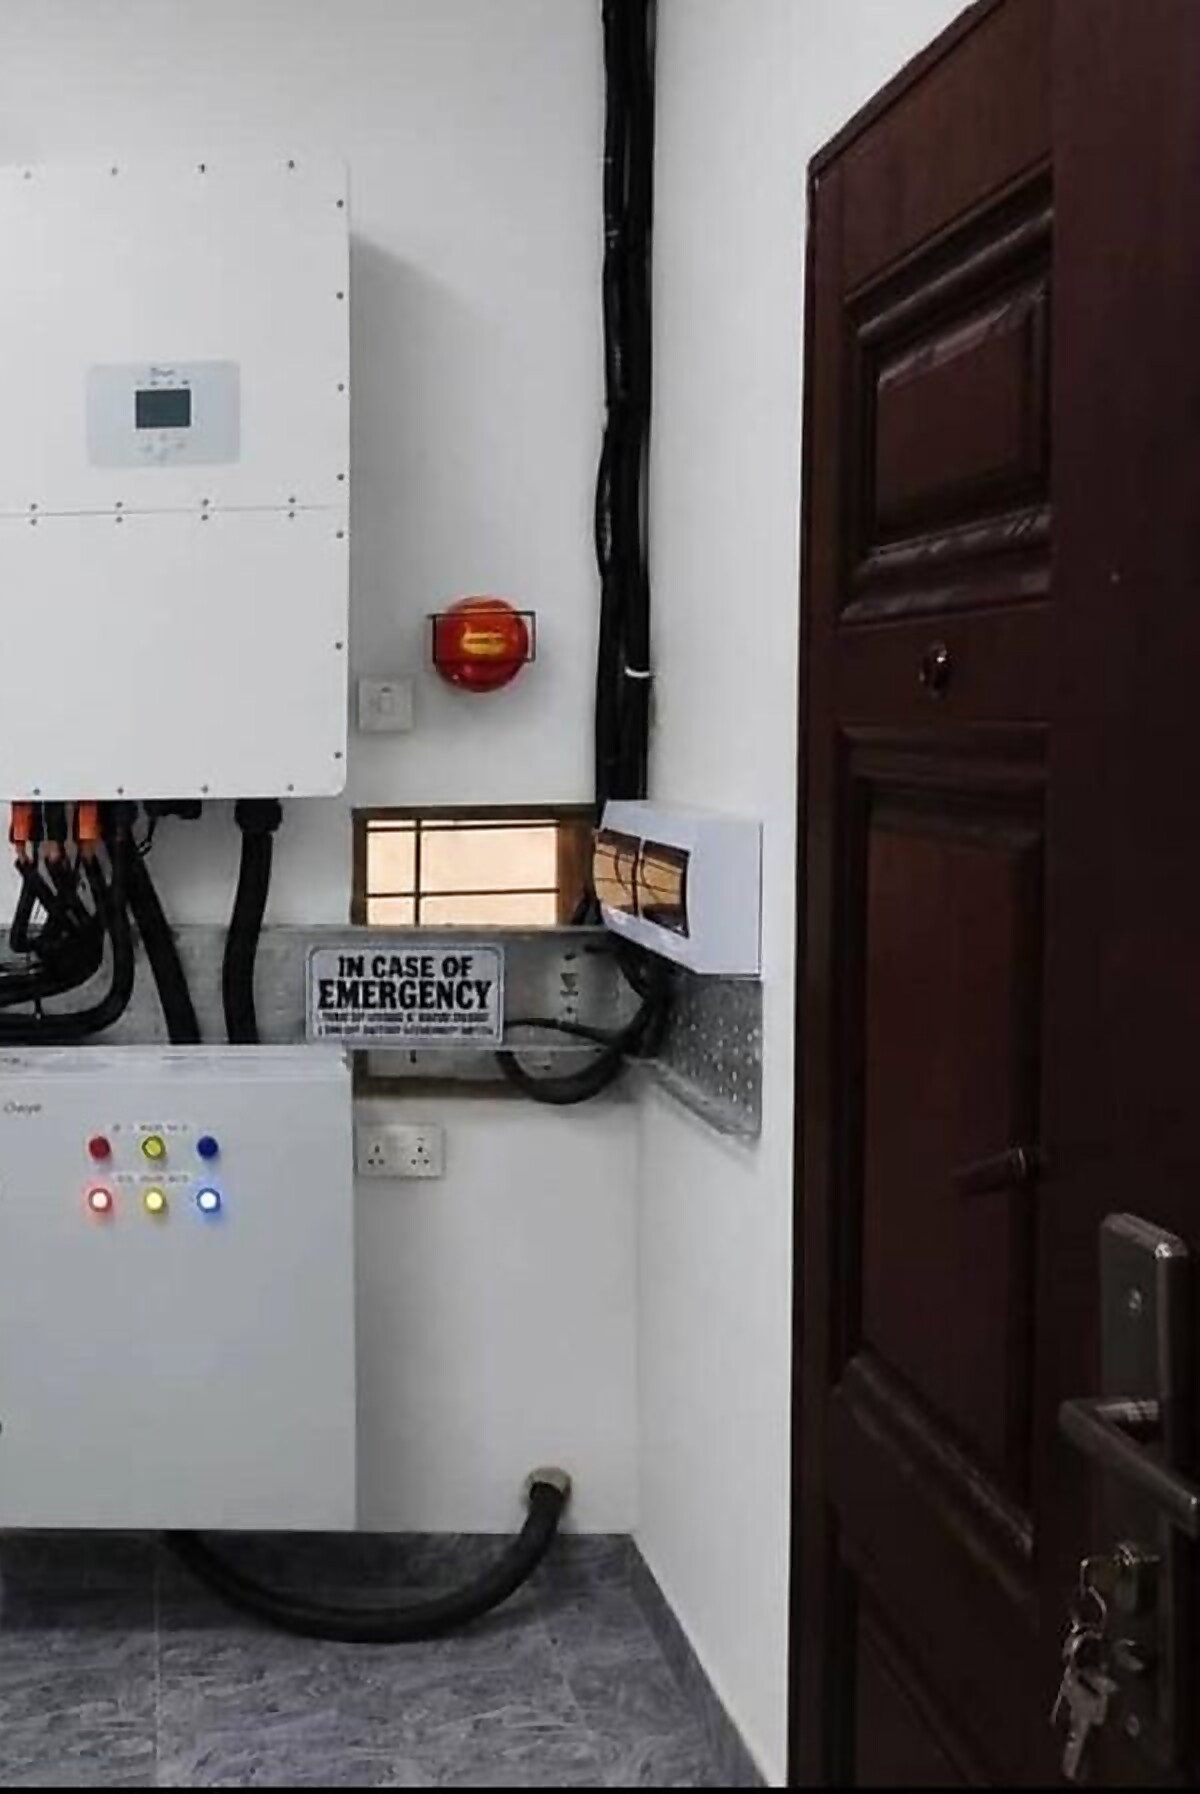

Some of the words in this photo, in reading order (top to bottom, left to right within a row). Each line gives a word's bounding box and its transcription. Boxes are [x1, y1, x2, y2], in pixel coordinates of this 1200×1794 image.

[338, 955, 364, 978] IN
[371, 955, 435, 978] CASE
[441, 955, 473, 978] OF
[318, 979, 493, 1010] EMERGENCY
